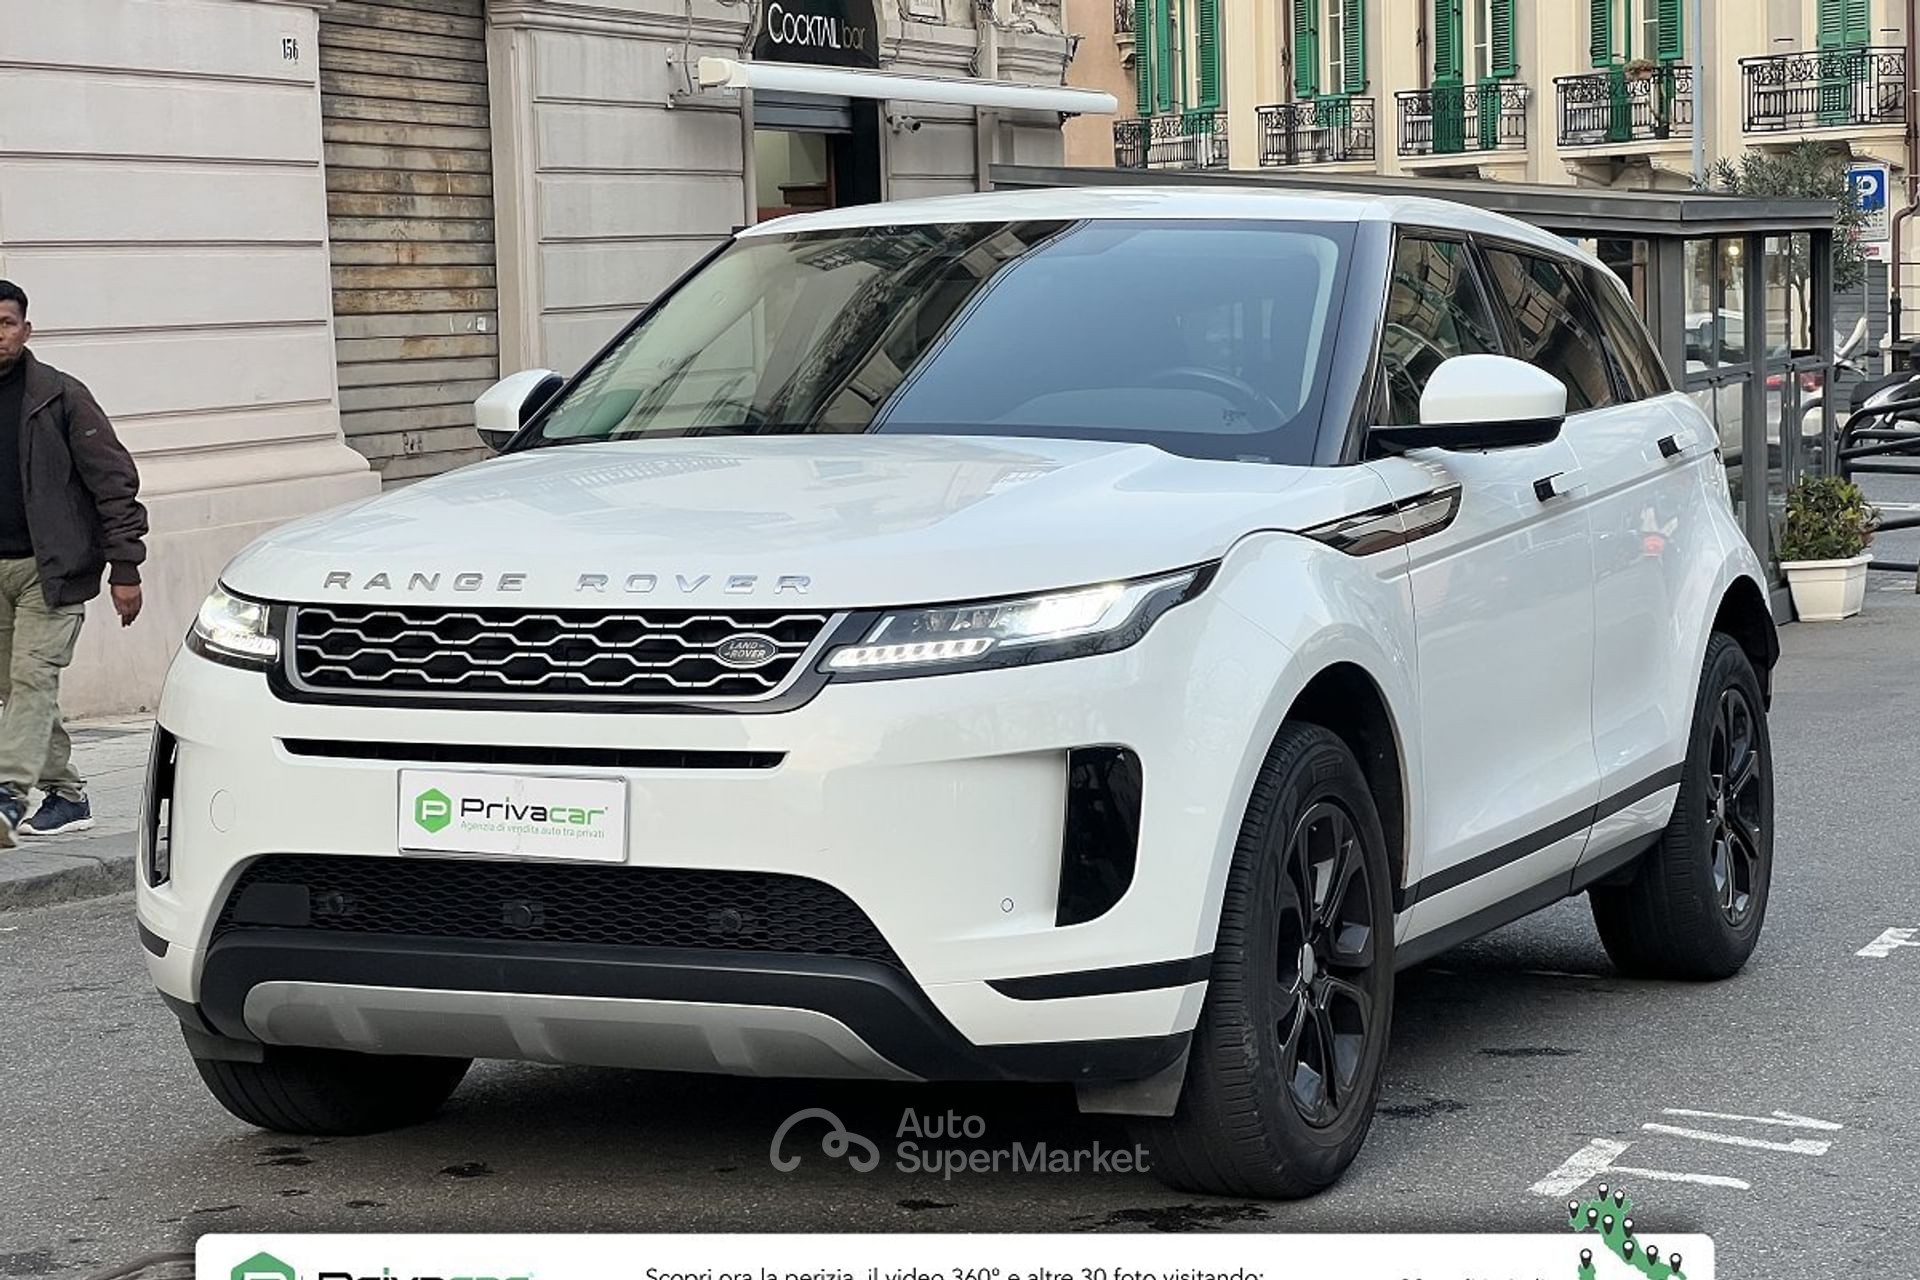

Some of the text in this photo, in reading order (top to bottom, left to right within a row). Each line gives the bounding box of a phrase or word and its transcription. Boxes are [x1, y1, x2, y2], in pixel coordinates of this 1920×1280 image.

[842, 24, 866, 50] bar
[1856, 175, 1878, 206] P
[322, 571, 812, 595] RANGE ROVER
[460, 797, 606, 826] Privacar
[460, 820, 605, 840] Agenzia di vendita auto tra privati
